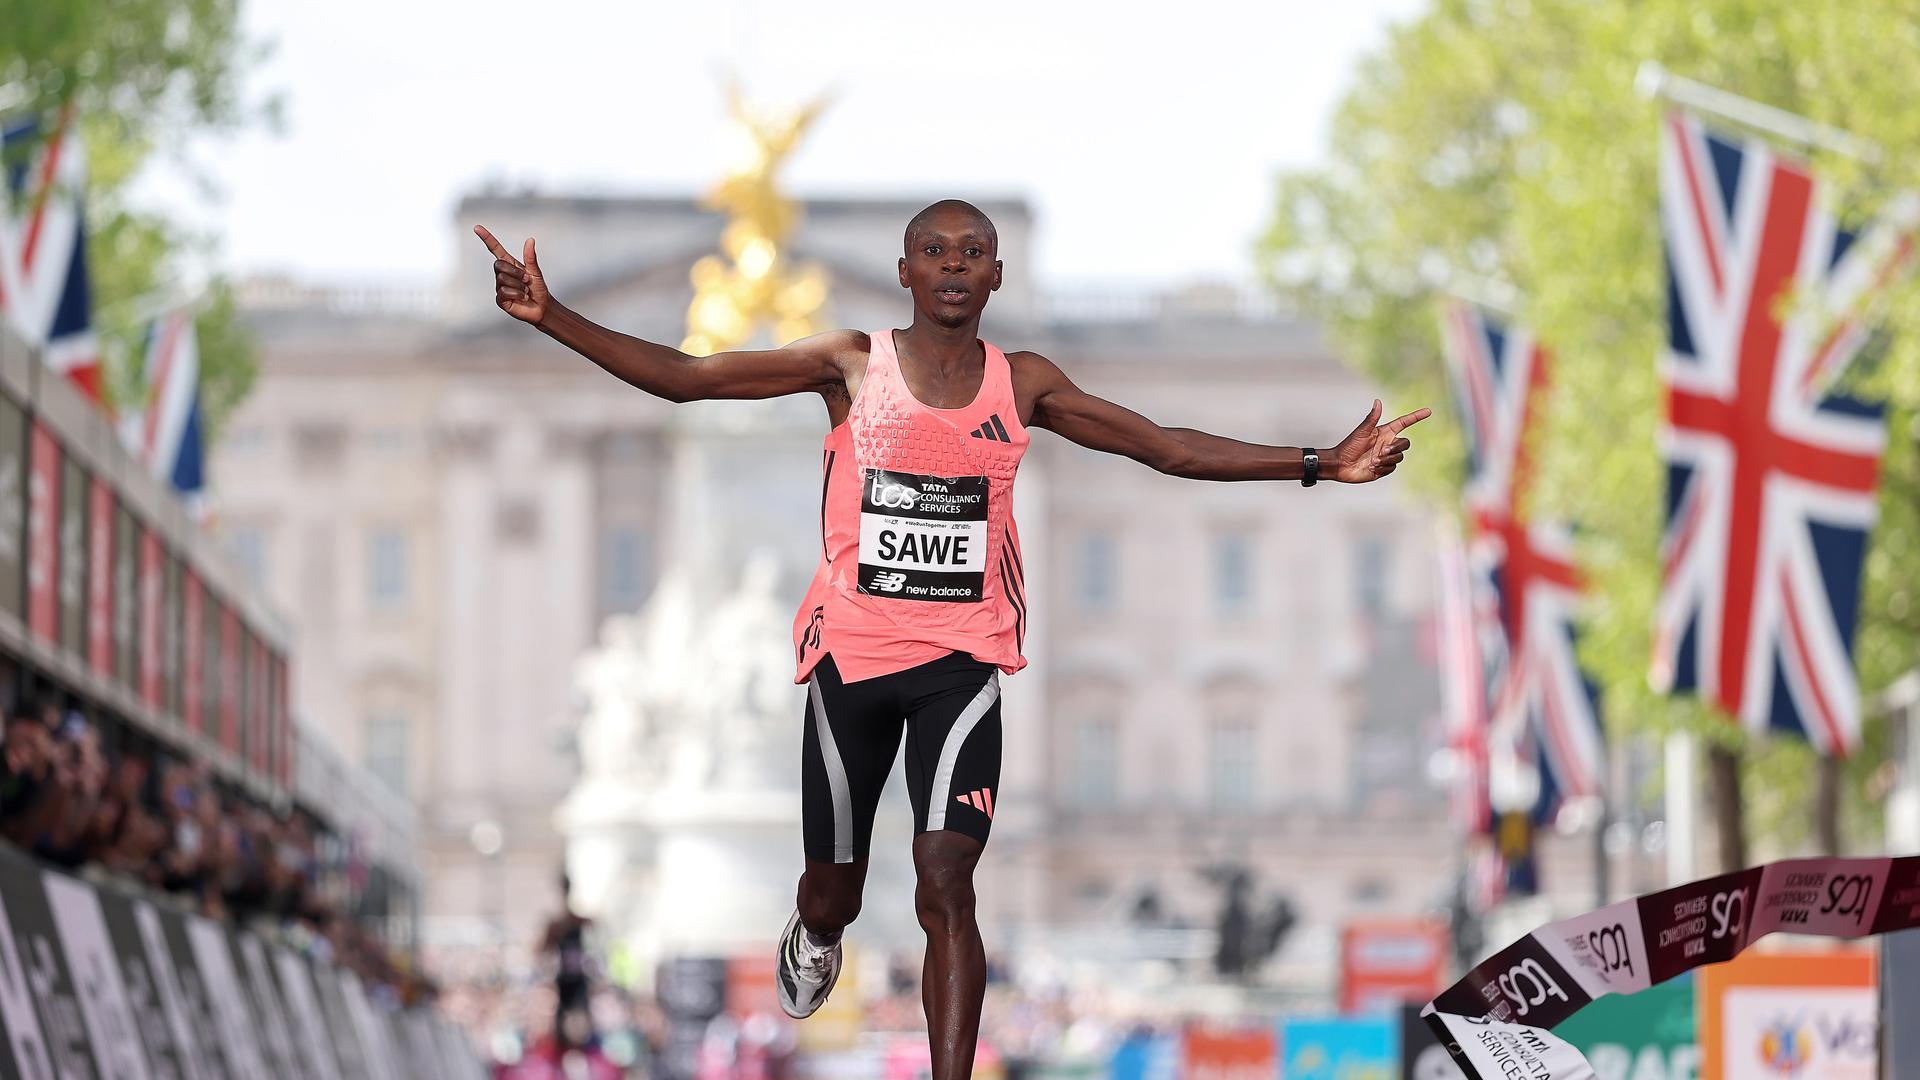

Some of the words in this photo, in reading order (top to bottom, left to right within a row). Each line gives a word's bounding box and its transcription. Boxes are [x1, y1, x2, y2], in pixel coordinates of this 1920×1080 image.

[870, 476, 921, 510] tcs
[920, 493, 981, 503] CONSULTANCY
[921, 483, 948, 493] TATA
[919, 503, 961, 514] SERVICES
[877, 530, 970, 565] SAWE
[906, 586, 928, 595] new
[930, 586, 972, 597] balance
[1711, 886, 1749, 939] cs
[1820, 874, 1873, 926] tcs
[1780, 907, 1809, 924] TATA
[1589, 923, 1635, 978] tcs
[1498, 958, 1569, 1016] tcs
[1519, 1029, 1551, 1054] TATA
